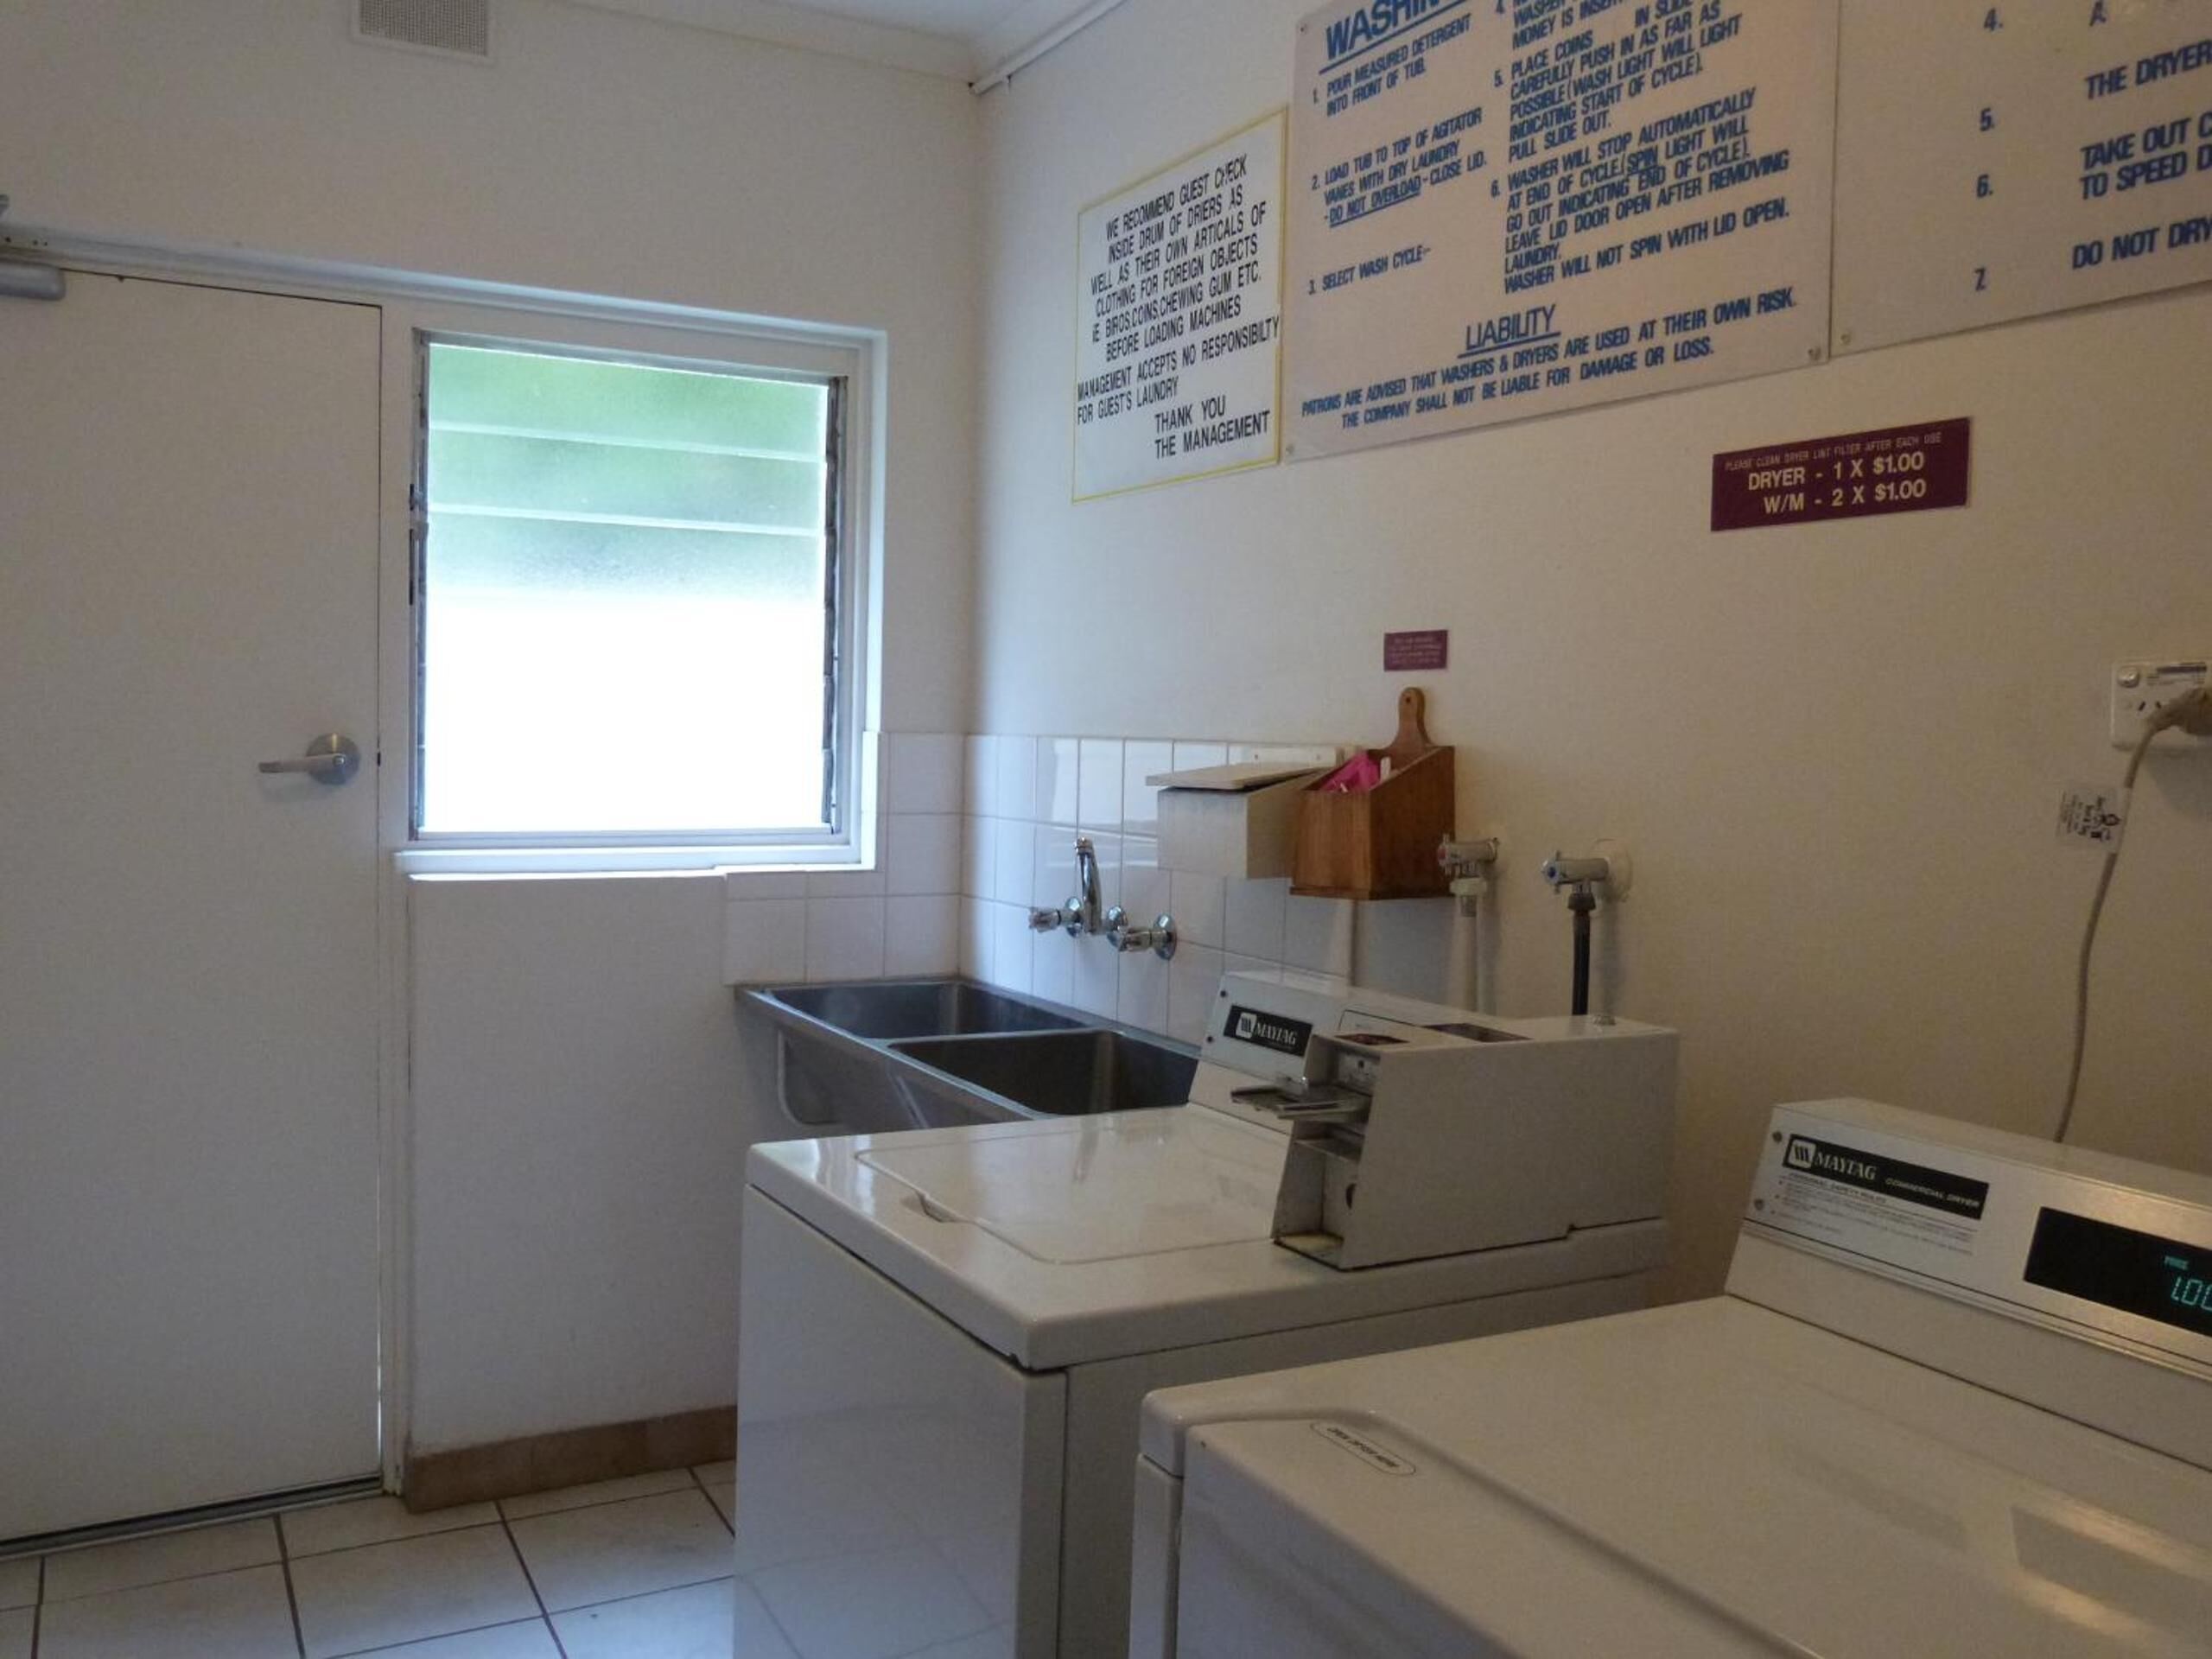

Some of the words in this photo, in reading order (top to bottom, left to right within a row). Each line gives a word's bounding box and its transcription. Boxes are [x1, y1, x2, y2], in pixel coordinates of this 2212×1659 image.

[1327, 73, 1351, 97] POUR
[1355, 45, 1408, 85] MEASURED
[1413, 13, 1471, 56] DETERGENT
[1511, 59, 1574, 100] CAREFULLY
[1581, 41, 1614, 71] PUSH
[1665, 12, 1691, 38] FAR
[1512, 15, 1555, 49] MONEY
[1512, 48, 1548, 78] PLACE
[1555, 29, 1592, 61] COINS
[1618, 48, 1656, 79] LIGHT
[1662, 34, 1695, 61] WILL
[1700, 13, 1742, 48] LIGHT
[1327, 94, 1348, 117] INTO
[1353, 77, 1382, 105] FRONT
[2084, 65, 2127, 100] THE
[1510, 102, 1576, 143] INDICATING
[1581, 82, 1624, 114] START
[1325, 162, 1349, 185] LOAD
[1354, 152, 1372, 174] TUB
[1393, 136, 1411, 156] TOP
[1433, 107, 1482, 142] AGITATOR
[1508, 157, 1558, 191] WASHER
[1562, 146, 1592, 171] WILL
[1598, 132, 1631, 159] STOP
[1638, 86, 1756, 145] AUTOMATICALLY
[1509, 137, 1536, 163] PULL
[1544, 122, 1577, 149] SLIDE
[1526, 182, 1550, 206] END
[1666, 129, 1706, 159] LIGHT
[1713, 115, 1749, 144] WILL
[2080, 133, 2136, 170] TAKE
[2142, 118, 2191, 153] OUT
[1106, 217, 1119, 242] WE
[1122, 190, 1175, 232] RECOMMEND
[1179, 173, 1210, 206] GUEST
[1215, 153, 1247, 188] CHECK
[1324, 181, 1354, 205] VANES
[1359, 169, 1383, 192] WITH
[1389, 159, 1408, 181] DRY
[1413, 139, 1460, 172] LAUNDRY
[1529, 203, 1553, 226] OUT
[1559, 178, 1630, 216] INDICATING
[1638, 166, 1666, 192] END
[1976, 175, 1993, 198] 6.
[2080, 172, 2108, 200] TO
[2117, 150, 2187, 191] SPEED
[1348, 196, 1366, 215] NOT
[1505, 226, 1541, 253] LEAVE
[1549, 219, 1567, 240] LID
[1574, 207, 1609, 233] DOOR
[1616, 191, 1651, 219] OPEN
[1656, 176, 1701, 208] AFTER
[1707, 149, 1789, 192] REMOVING
[1090, 270, 1113, 295] WELL
[1135, 248, 1160, 276] THEIR
[1166, 235, 1188, 263] OWN
[1194, 211, 1244, 251] ARTICALS
[1108, 234, 1134, 264] INSIDE
[1140, 220, 1164, 251] DRUM
[1187, 194, 1222, 227] DRIERS
[1504, 265, 1554, 294] WASHER
[1561, 254, 1592, 278] WILL
[1597, 245, 1624, 268] NOT
[1630, 234, 1662, 259] SPIN
[1667, 219, 1708, 248] WITH
[1713, 212, 1736, 236] LID
[1743, 197, 1789, 227] OPEN.
[2072, 239, 2103, 270] DO
[2111, 226, 2160, 262] NOT
[1096, 283, 1135, 317] CLOTHING
[1141, 274, 1158, 298] FOR
[1163, 255, 1204, 290] FOREIGN
[1211, 232, 1257, 270] OBJECTS
[1209, 270, 1231, 297] GUM
[1237, 260, 1261, 288] ETC.
[1322, 266, 1356, 291] SELECT
[1359, 256, 1388, 280] WASH
[1106, 332, 1139, 362] BEFORE
[1144, 315, 1184, 347] LOADING
[1190, 295, 1241, 332] MACHINES
[1465, 303, 1555, 351] LIABILITY
[1077, 366, 1131, 401] MANAGEMENT
[1136, 351, 1177, 383] ACCEPTS
[1182, 344, 1196, 366] NO
[1302, 393, 1341, 417] PATRONS
[1345, 389, 1362, 407] ARE
[1366, 378, 1407, 401] ADVISED
[1412, 371, 1438, 392] THAT
[1440, 358, 1494, 385] WASHERS
[1513, 343, 1560, 371] DRYERS
[1564, 336, 1590, 359] ARE
[1595, 326, 1630, 352] USED
[1662, 308, 1707, 336] THEIR
[1713, 296, 1751, 325] OWN
[1077, 404, 1094, 425] FOR
[1137, 375, 1179, 407] LAUNDRY
[1343, 411, 1359, 429] THE
[1363, 400, 1410, 424] COMPANY
[1415, 392, 1447, 414] SHALL
[1452, 385, 1475, 406] NOT
[1501, 372, 1541, 396] LIABLE
[1547, 367, 1570, 388] FOR
[1580, 351, 1637, 380] DAMAGE
[1674, 337, 1713, 363] LOSS.
[1154, 404, 1192, 434] THANK
[1201, 394, 1225, 422] YOU
[1154, 435, 1176, 459] THE
[1183, 409, 1271, 452] MANAGEMENT
[1725, 458, 1753, 471] PLEASE
[1757, 455, 1779, 467] CLEAN
[1784, 449, 1809, 463] DRYER
[1814, 448, 1832, 459] LINT
[1834, 442, 1860, 455] FILTER
[1866, 440, 1891, 451] AFTER
[1897, 435, 1918, 448] EACH
[1924, 431, 1942, 444] USE
[1748, 467, 1806, 491] DRYER
[1834, 461, 1842, 480] 1
[1850, 458, 1864, 479] X
[1873, 451, 1924, 475] $1.00
[1764, 493, 1804, 514] W/M
[1832, 487, 1843, 506] 2
[1852, 485, 1865, 505] X
[1875, 478, 1927, 501] $1.00
[1254, 1021, 1297, 1046] MAYTAG
[1815, 1150, 1877, 1181] MAYTAG
